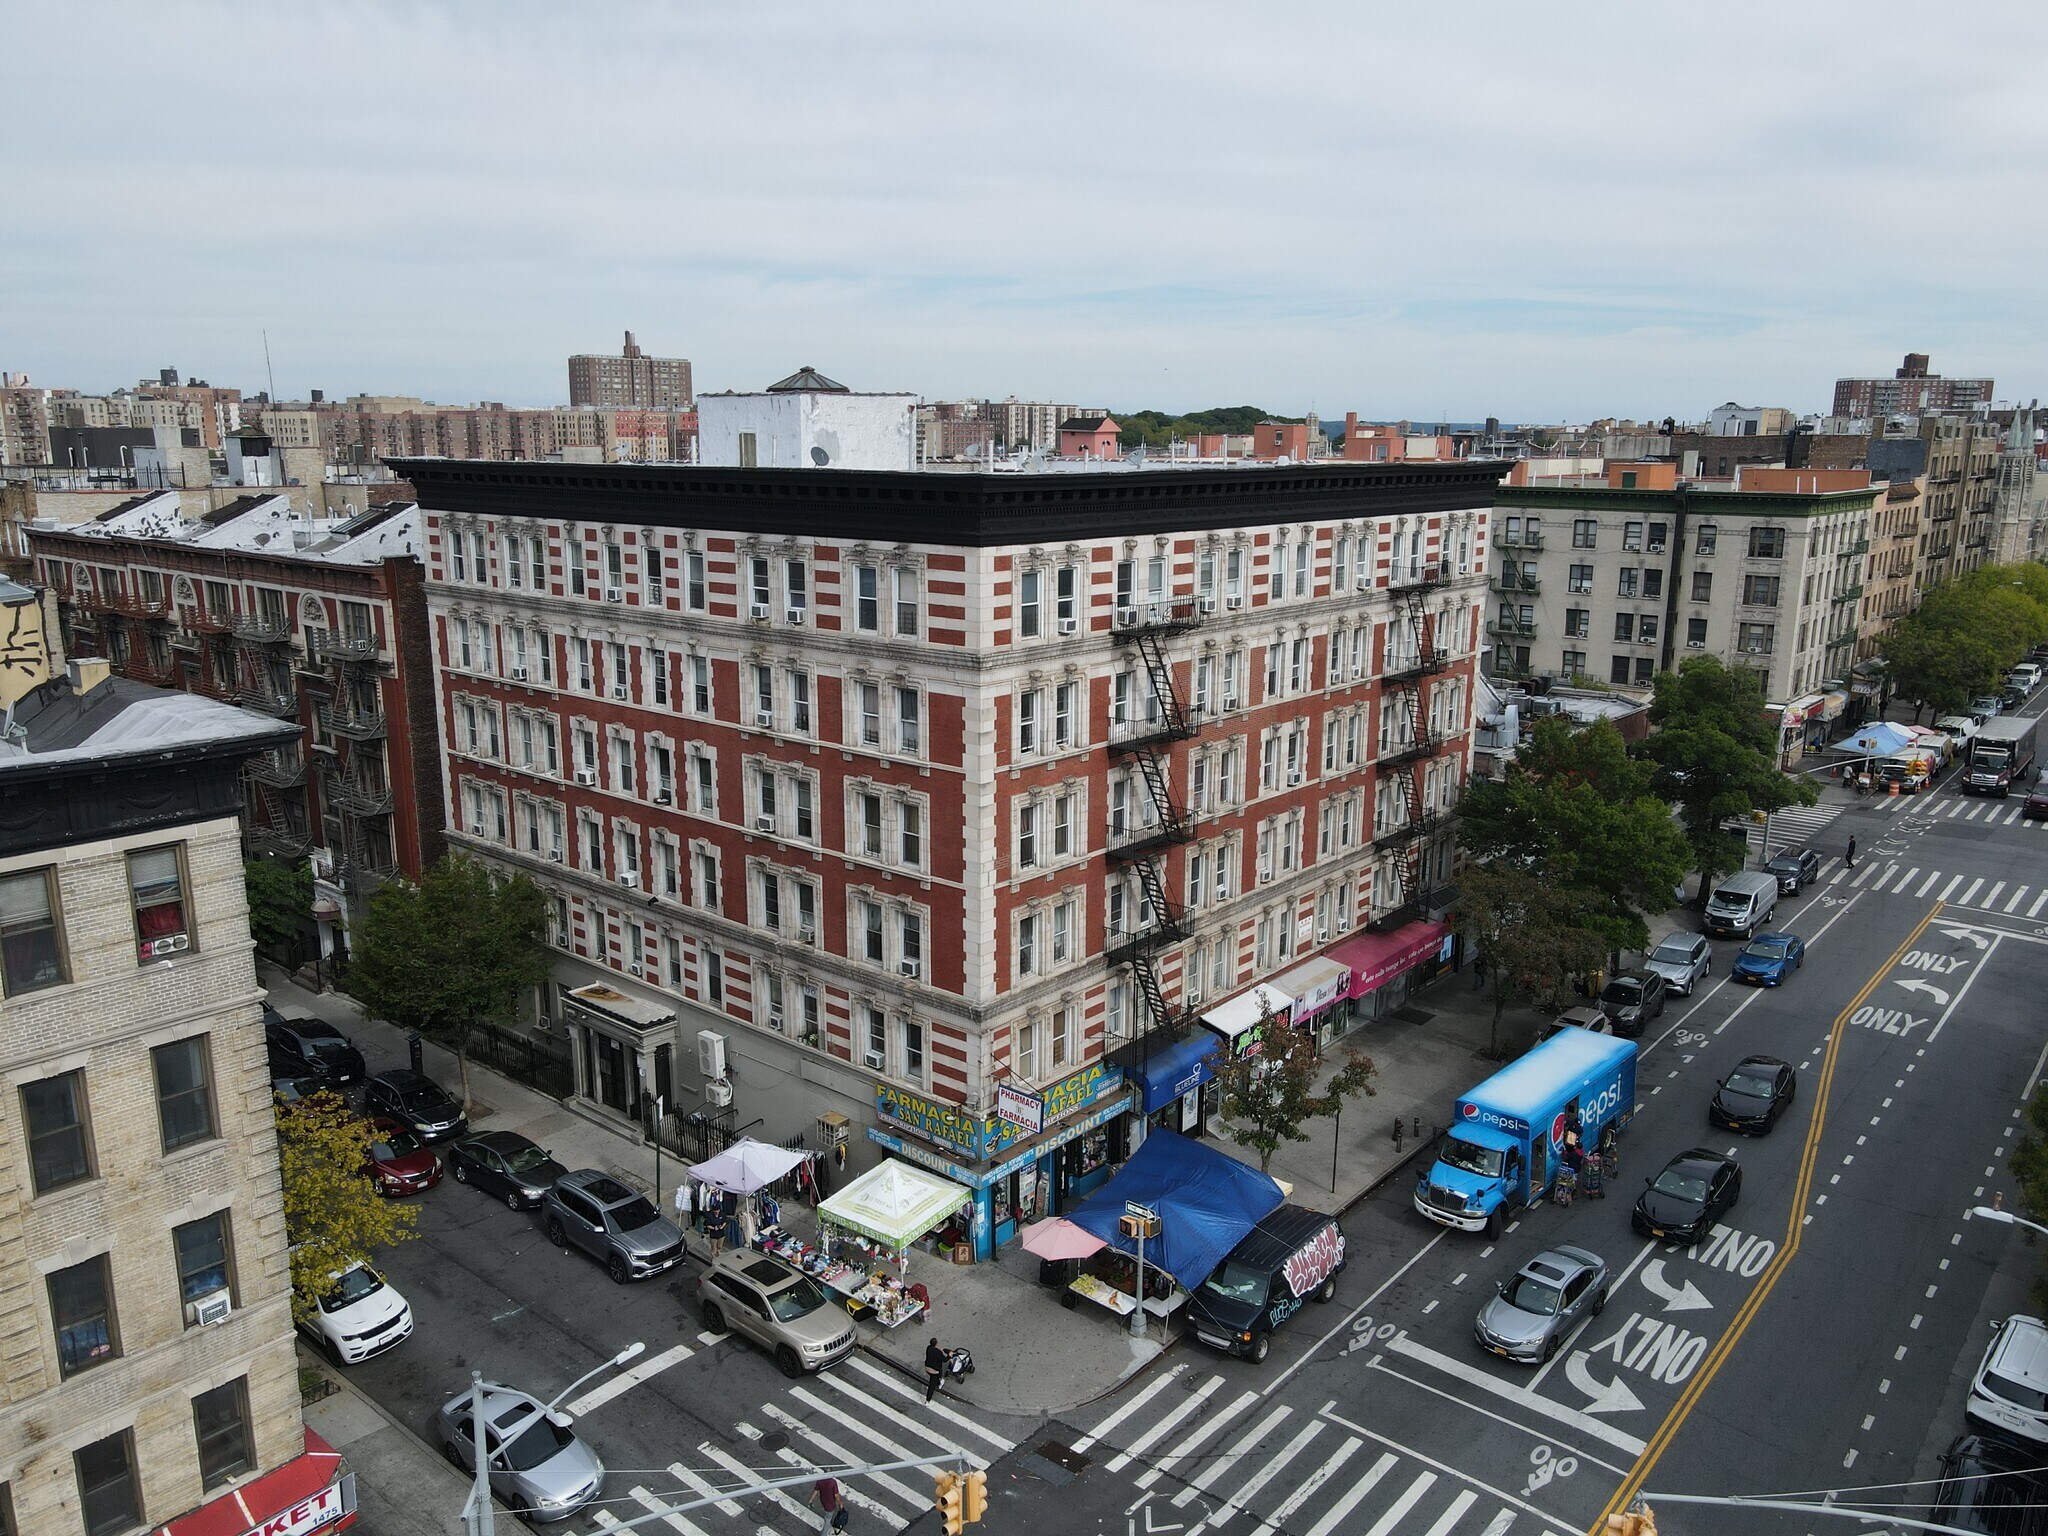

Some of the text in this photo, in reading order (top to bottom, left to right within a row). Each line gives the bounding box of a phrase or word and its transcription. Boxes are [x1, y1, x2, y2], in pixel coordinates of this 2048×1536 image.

[1900, 951, 1970, 975] ONLY
[1850, 1006, 1929, 1037] ONLY
[1000, 1088, 1040, 1110] PHARMACY
[1175, 1074, 1200, 1093] BLUELINE
[877, 1085, 975, 1135] FARMACIA
[1043, 1084, 1094, 1120] AFAEL
[899, 1107, 920, 1126] SAN
[925, 1117, 972, 1148] RAFAEL
[1000, 1108, 1039, 1131] FARMACIA
[1482, 1112, 1519, 1131] pepsi
[1035, 1114, 1102, 1159] DISCOUNT
[901, 1142, 951, 1174] DISCOUNT
[821, 1209, 858, 1231] COVID-19
[860, 1224, 896, 1247] TESTING
[903, 1215, 938, 1246] COVID-19
[938, 1193, 970, 1219] TESTING
[1589, 1312, 1708, 1385] ONLY
[312, 1506, 338, 1526] 1475
